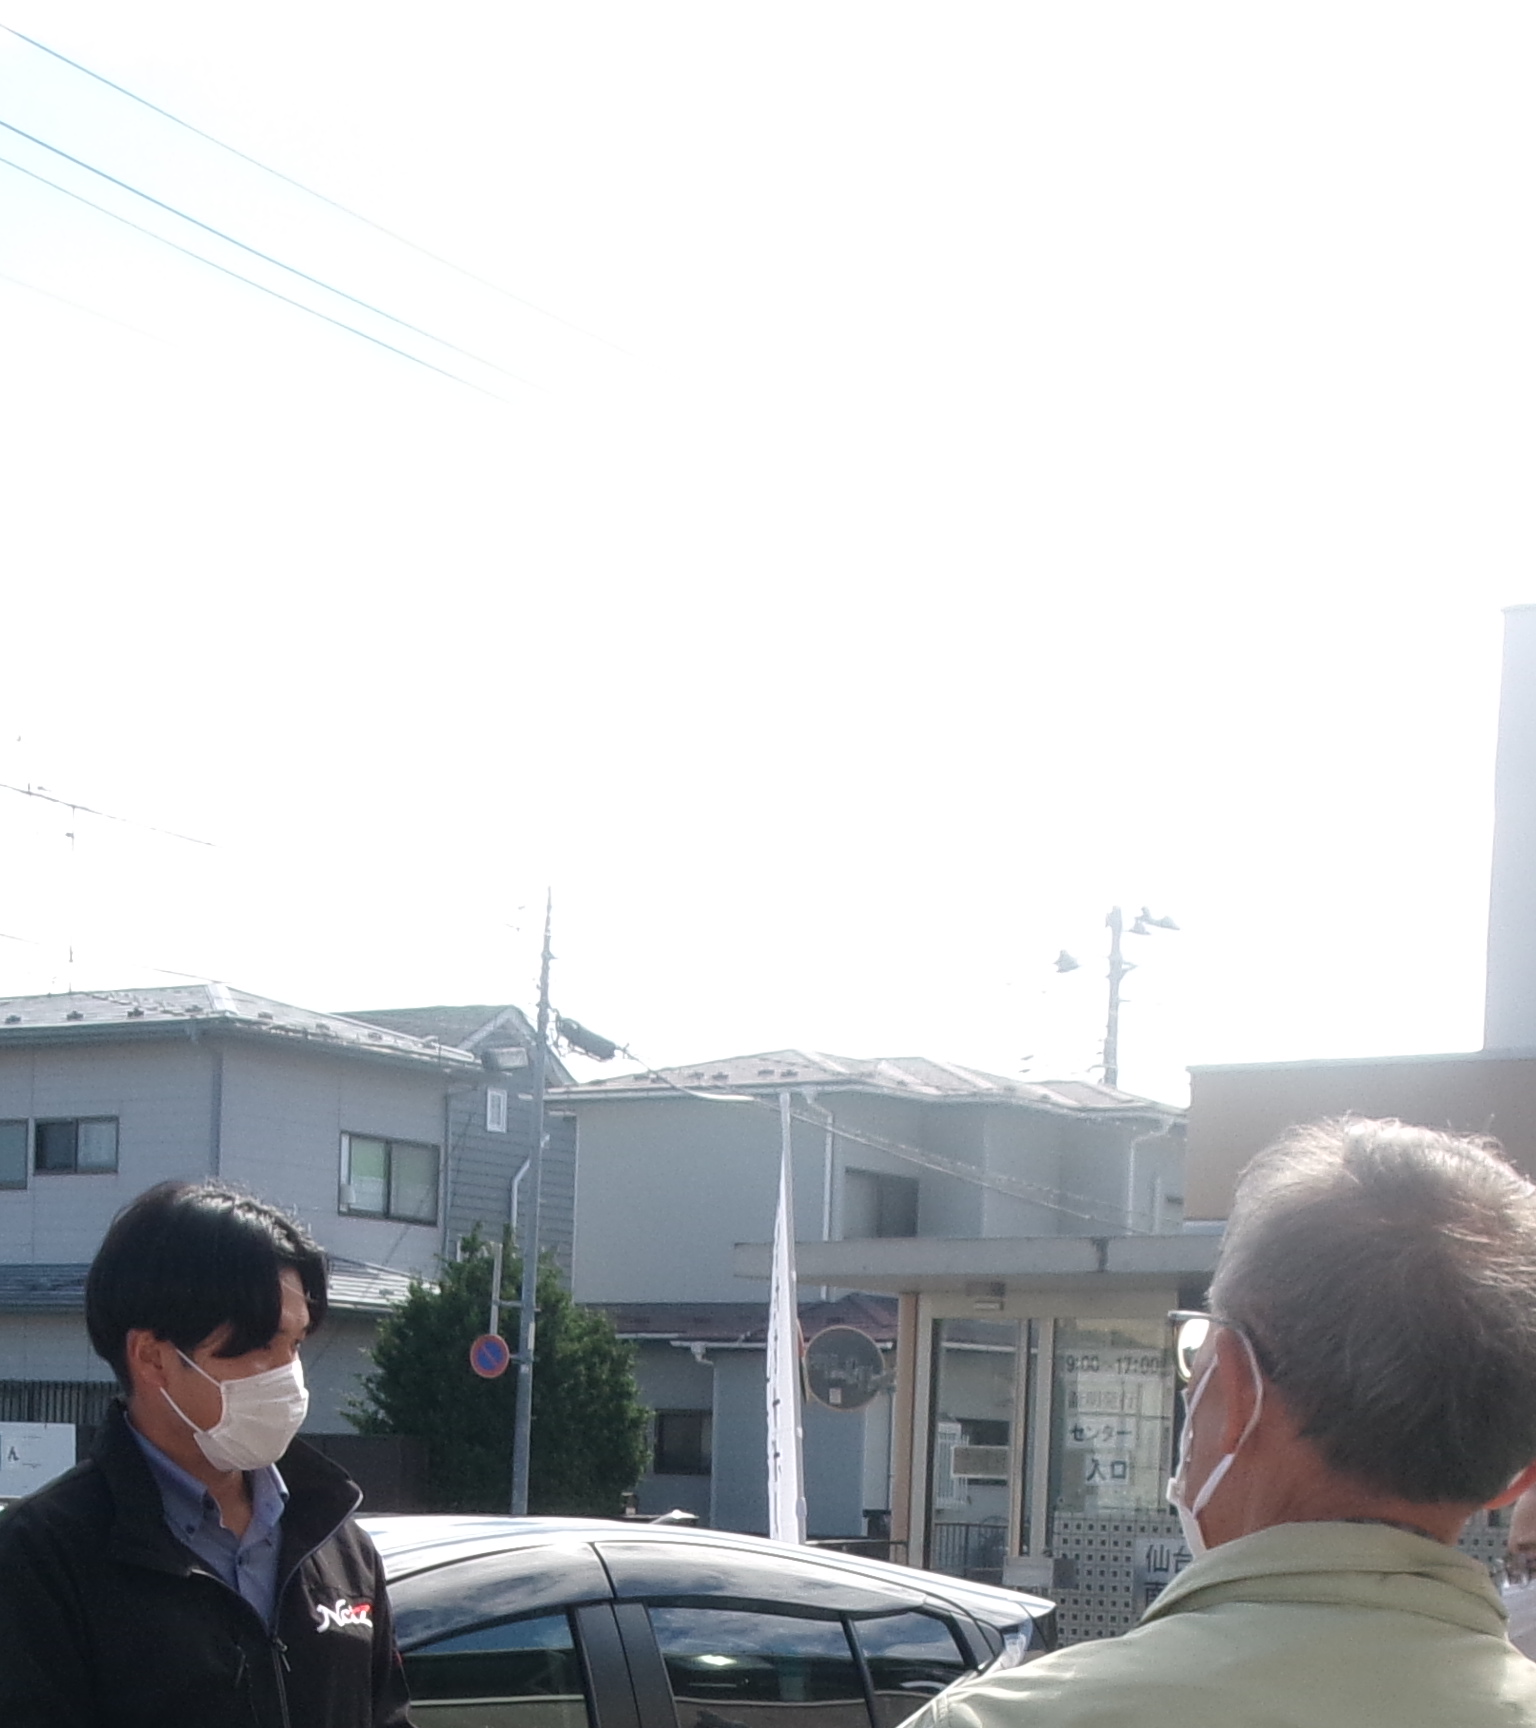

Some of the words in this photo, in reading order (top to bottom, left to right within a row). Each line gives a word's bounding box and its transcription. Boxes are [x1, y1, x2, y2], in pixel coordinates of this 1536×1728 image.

[1069, 1423, 1133, 1442] センター
[1086, 1457, 1127, 1482] 入口
